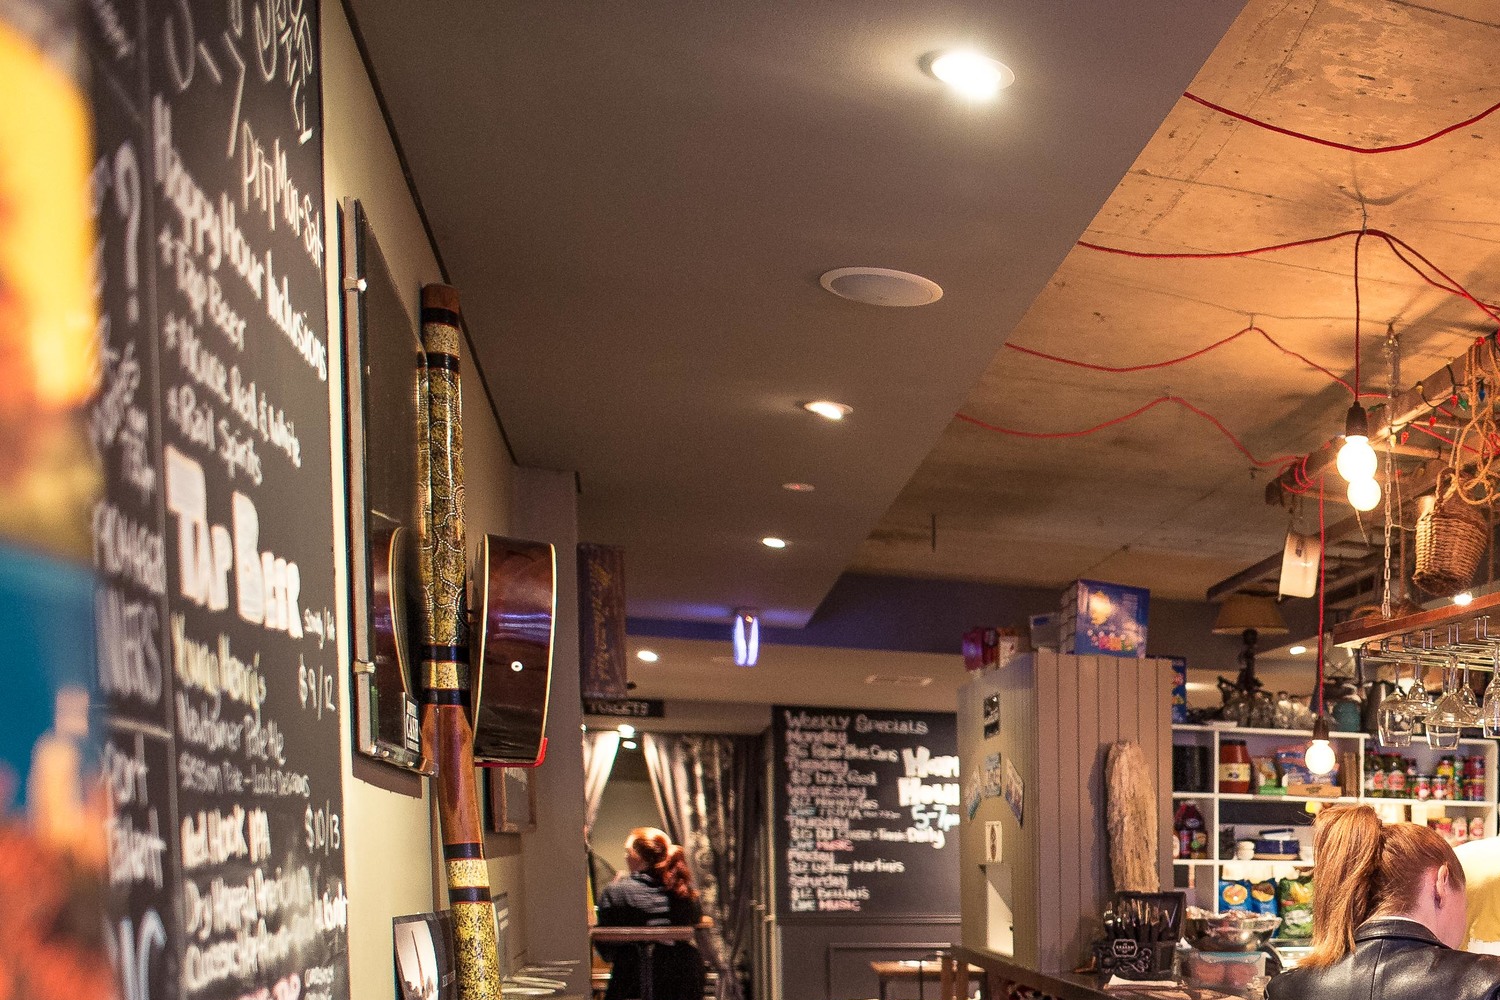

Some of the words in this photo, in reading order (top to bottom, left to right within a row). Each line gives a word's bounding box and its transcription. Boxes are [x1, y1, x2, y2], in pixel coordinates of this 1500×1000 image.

[220, 189, 262, 302] Hour
[265, 250, 326, 382] Inclusions
[304, 799, 340, 854] $10/13
